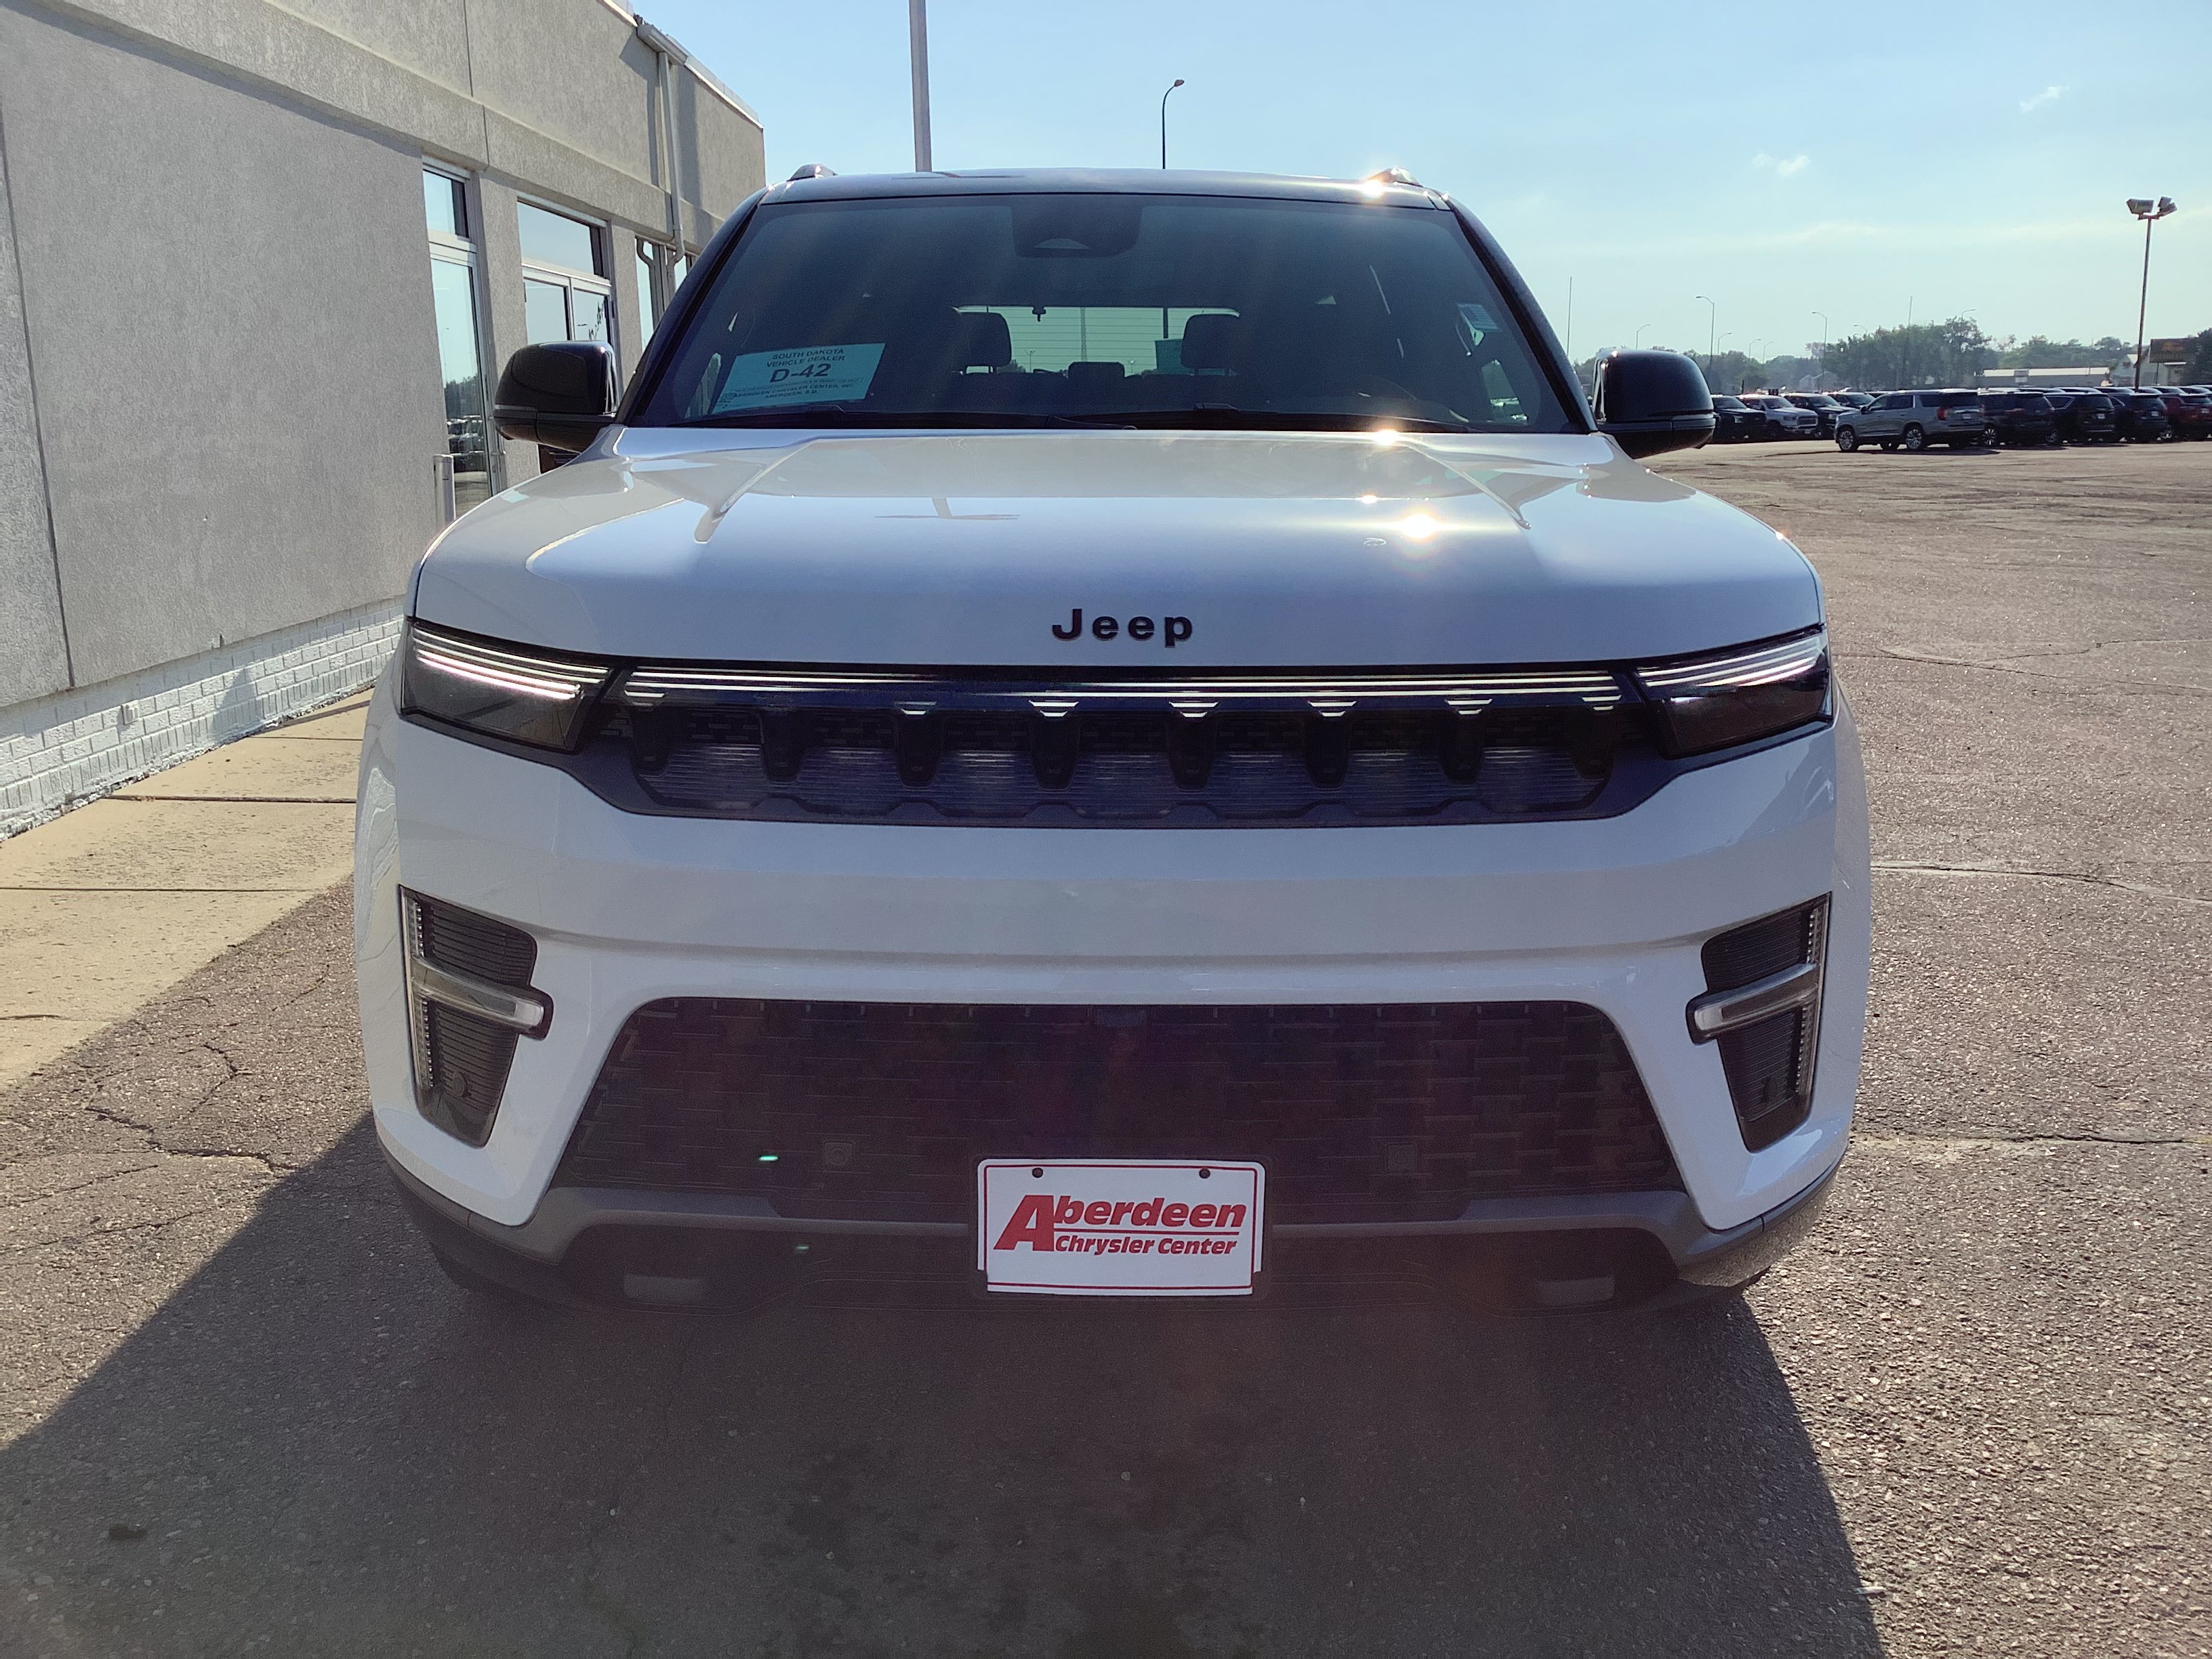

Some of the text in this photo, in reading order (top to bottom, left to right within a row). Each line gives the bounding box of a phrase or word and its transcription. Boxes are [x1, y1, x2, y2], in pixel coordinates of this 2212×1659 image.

[766, 359, 804, 367] VEHICLE
[773, 348, 844, 360] SOUTH DAKOTA
[770, 363, 832, 383] D-42
[1052, 608, 1193, 648] Jeep
[994, 1194, 1247, 1252] Aberdeen
[1055, 1235, 1237, 1256] Chrysler Center
